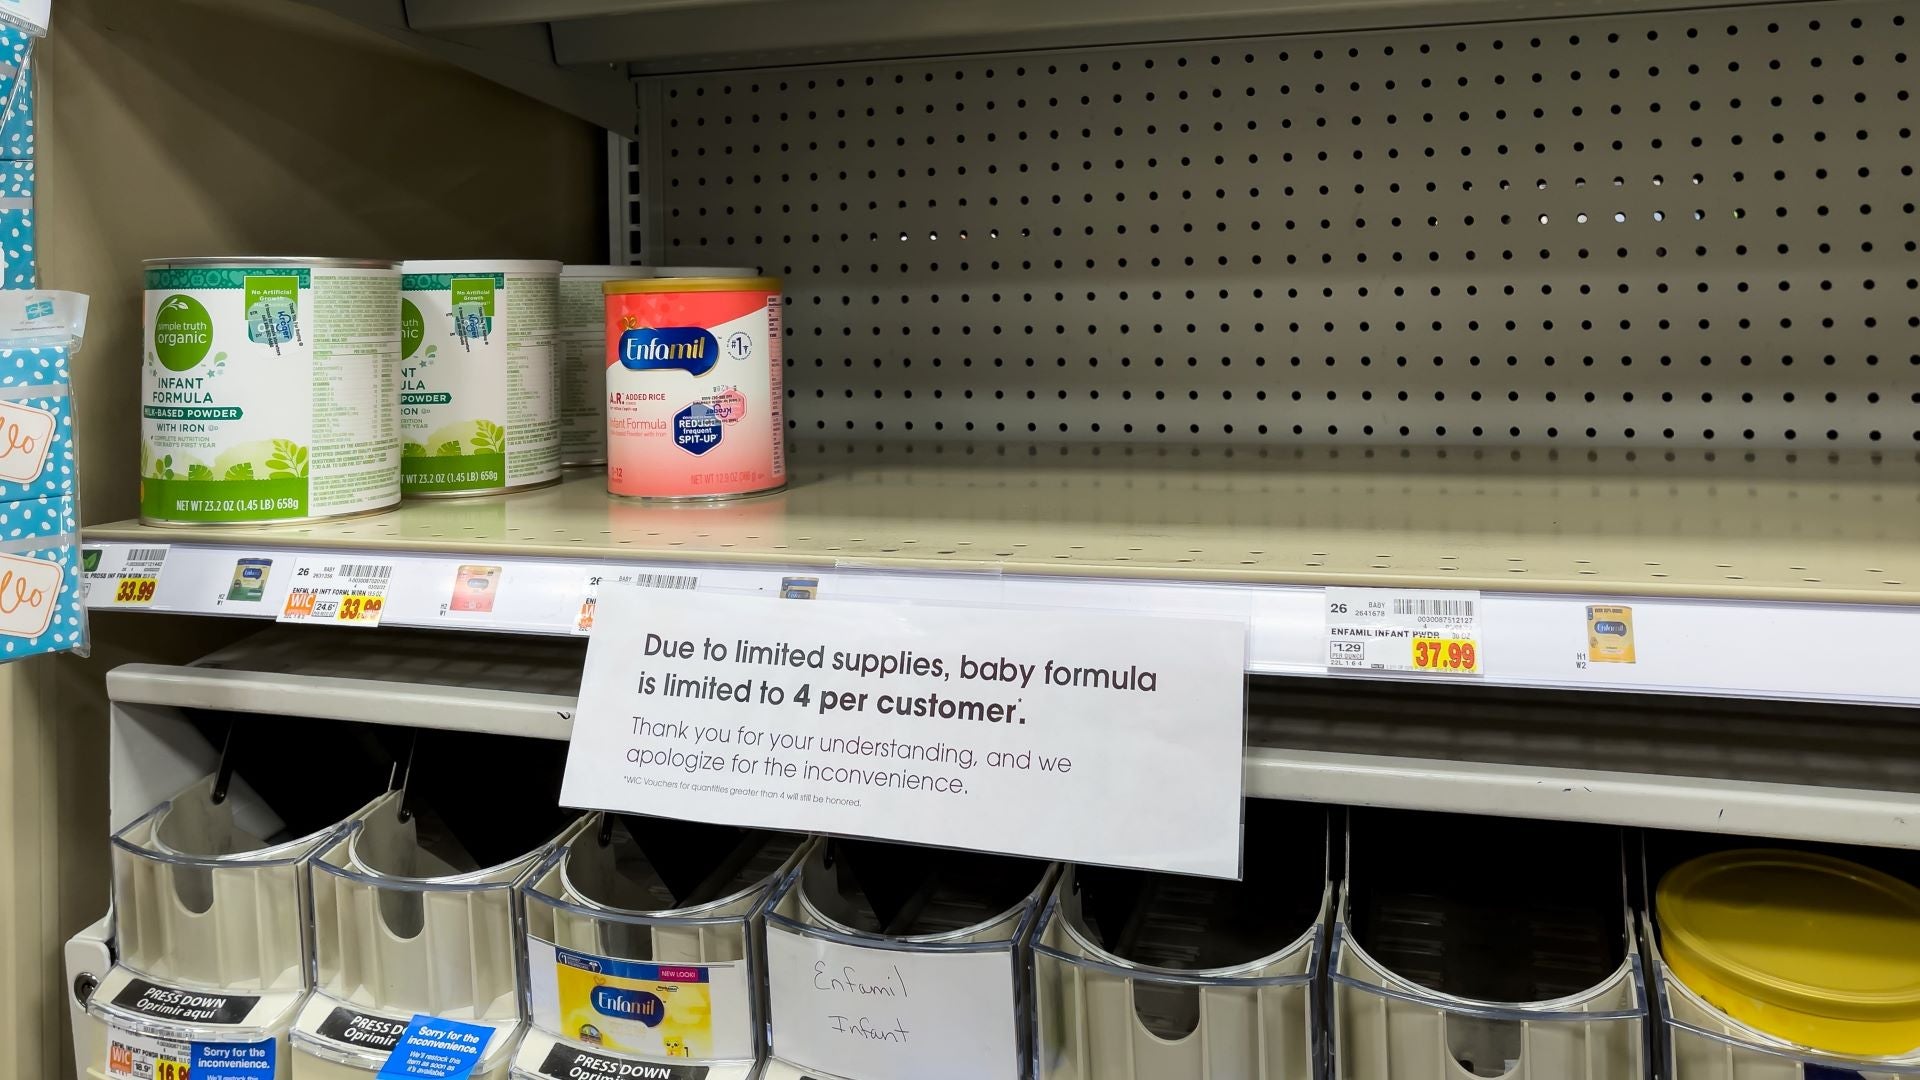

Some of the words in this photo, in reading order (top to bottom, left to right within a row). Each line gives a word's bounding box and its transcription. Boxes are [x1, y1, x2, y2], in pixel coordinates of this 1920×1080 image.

[183, 321, 207, 331] truth
[276, 311, 294, 339] Kroger
[157, 331, 207, 347] organic
[626, 337, 706, 360] Enfamil
[158, 377, 204, 389] INFANT
[152, 391, 214, 404] FORMULA
[401, 395, 447, 403] POWDER
[187, 409, 238, 418] POWDER
[156, 423, 177, 432] WITH
[179, 424, 205, 432] IRON
[626, 418, 667, 430] Formula
[679, 419, 716, 428] REDUCE
[679, 434, 717, 444] SPIT-UP
[683, 428, 713, 436] frequent
[406, 474, 417, 484] WT
[436, 473, 446, 483] OZ
[447, 472, 465, 483] (1.45
[467, 471, 479, 482] LB)
[480, 470, 498, 481] 658g
[176, 500, 189, 511] NET
[191, 500, 203, 512] WT
[204, 500, 221, 512] 23.2
[223, 500, 234, 512] OZ
[236, 499, 259, 512] (1.45
[260, 498, 275, 511] LB)
[277, 498, 299, 510] 658g
[297, 567, 310, 576] 26
[117, 581, 156, 601] 33.99
[291, 595, 315, 608] WIC
[1330, 603, 1348, 614] 26
[1417, 616, 1473, 624] 0030087512127
[1331, 627, 1373, 636] ENFAMIL
[1374, 630, 1410, 638] INFANT
[1415, 641, 1476, 669] 37.99
[643, 633, 695, 660] Due
[703, 637, 728, 662] to
[735, 639, 825, 669] limited
[832, 650, 950, 682] supplies,
[960, 654, 1036, 689] baby
[1044, 659, 1158, 692] formula
[1576, 661, 1587, 670] W2
[637, 671, 656, 695] is
[662, 673, 752, 703] limited
[760, 681, 785, 706] to
[793, 683, 811, 707] 4
[819, 689, 869, 715] per
[632, 716, 689, 740] Thank
[694, 726, 731, 745] you
[737, 725, 764, 746] for
[770, 732, 815, 752] your
[819, 735, 978, 770] understanding,
[986, 750, 1032, 770] and
[1038, 755, 1072, 773] we
[626, 747, 725, 773] apologize
[731, 753, 759, 775] for
[764, 757, 797, 778] the
[803, 760, 969, 795] inconvenience.
[643, 777, 678, 789] Vouchers
[679, 780, 690, 790] for
[690, 782, 729, 794] quantities
[729, 787, 759, 797] greater
[760, 789, 779, 799] than
[779, 791, 785, 799] 4
[786, 791, 799, 801] will
[799, 793, 812, 802] still
[812, 795, 824, 803] be
[825, 796, 862, 807] honored.
[661, 970, 676, 978] NEW
[676, 970, 696, 979] LOOK!
[813, 960, 907, 998] Enfamil
[143, 987, 182, 1004] PRESS
[181, 995, 227, 1009] DOWN
[598, 991, 655, 1016] Enfamil
[136, 998, 185, 1016] Oprimir
[183, 1008, 217, 1020] aquí
[350, 1015, 393, 1034] PRESS
[827, 1015, 910, 1043] Infant
[343, 1027, 396, 1046] Oprimir
[418, 1025, 447, 1040] Sorry
[446, 1030, 462, 1041] for
[463, 1032, 480, 1043] the
[407, 1035, 478, 1055] inconvenience.
[111, 1047, 131, 1065] WIC
[203, 1046, 229, 1059] Sorry
[232, 1046, 246, 1057] for
[252, 1047, 266, 1058] the
[409, 1050, 425, 1060] We'll
[424, 1052, 448, 1063] restock
[448, 1055, 462, 1065] this
[198, 1055, 270, 1069] inconvenience.
[406, 1058, 421, 1067] item
[429, 1061, 446, 1070] soon
[573, 1054, 619, 1074] PRESS
[619, 1064, 672, 1080] DOWN
[416, 1066, 445, 1077] available.
